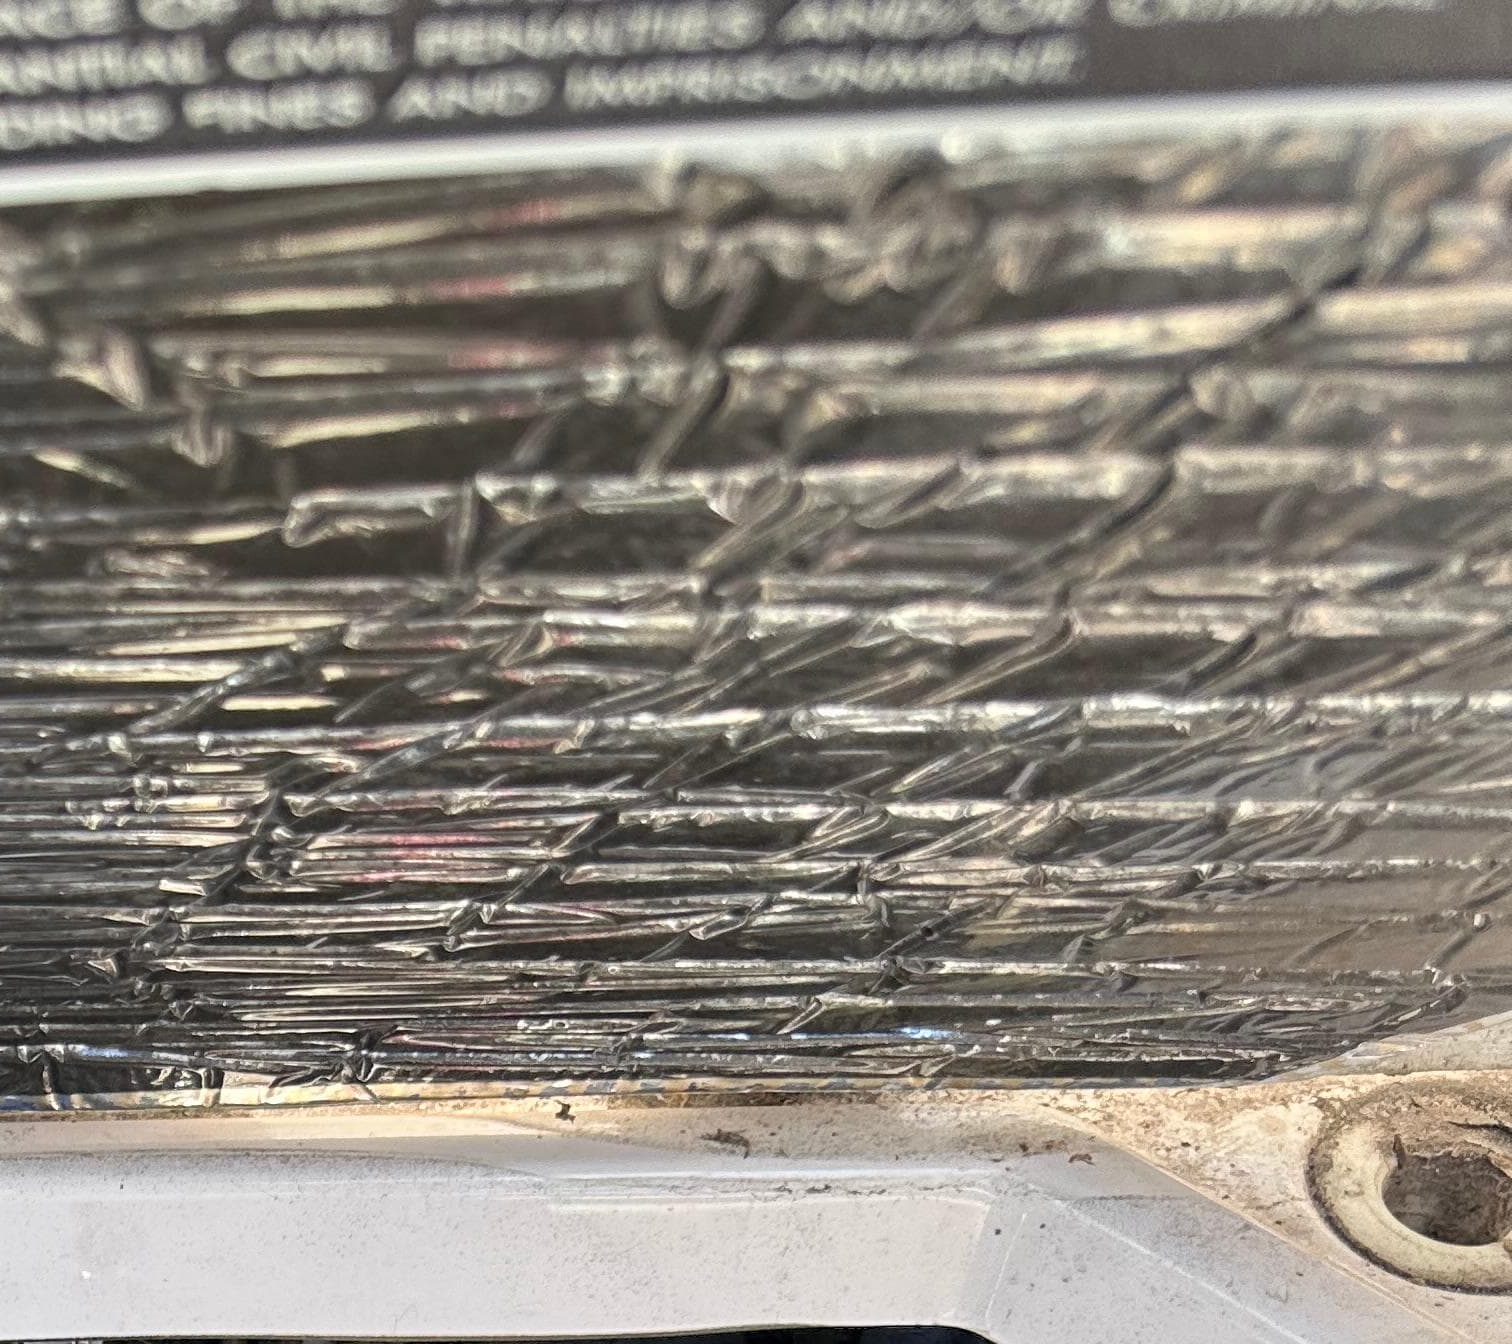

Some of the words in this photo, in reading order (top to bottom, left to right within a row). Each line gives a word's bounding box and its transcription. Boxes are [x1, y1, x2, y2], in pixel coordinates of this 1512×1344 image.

[226, 21, 392, 80] CIVIL
[414, 7, 766, 66] PENALTIES
[184, 78, 375, 134] FINES
[390, 67, 552, 123] AND
